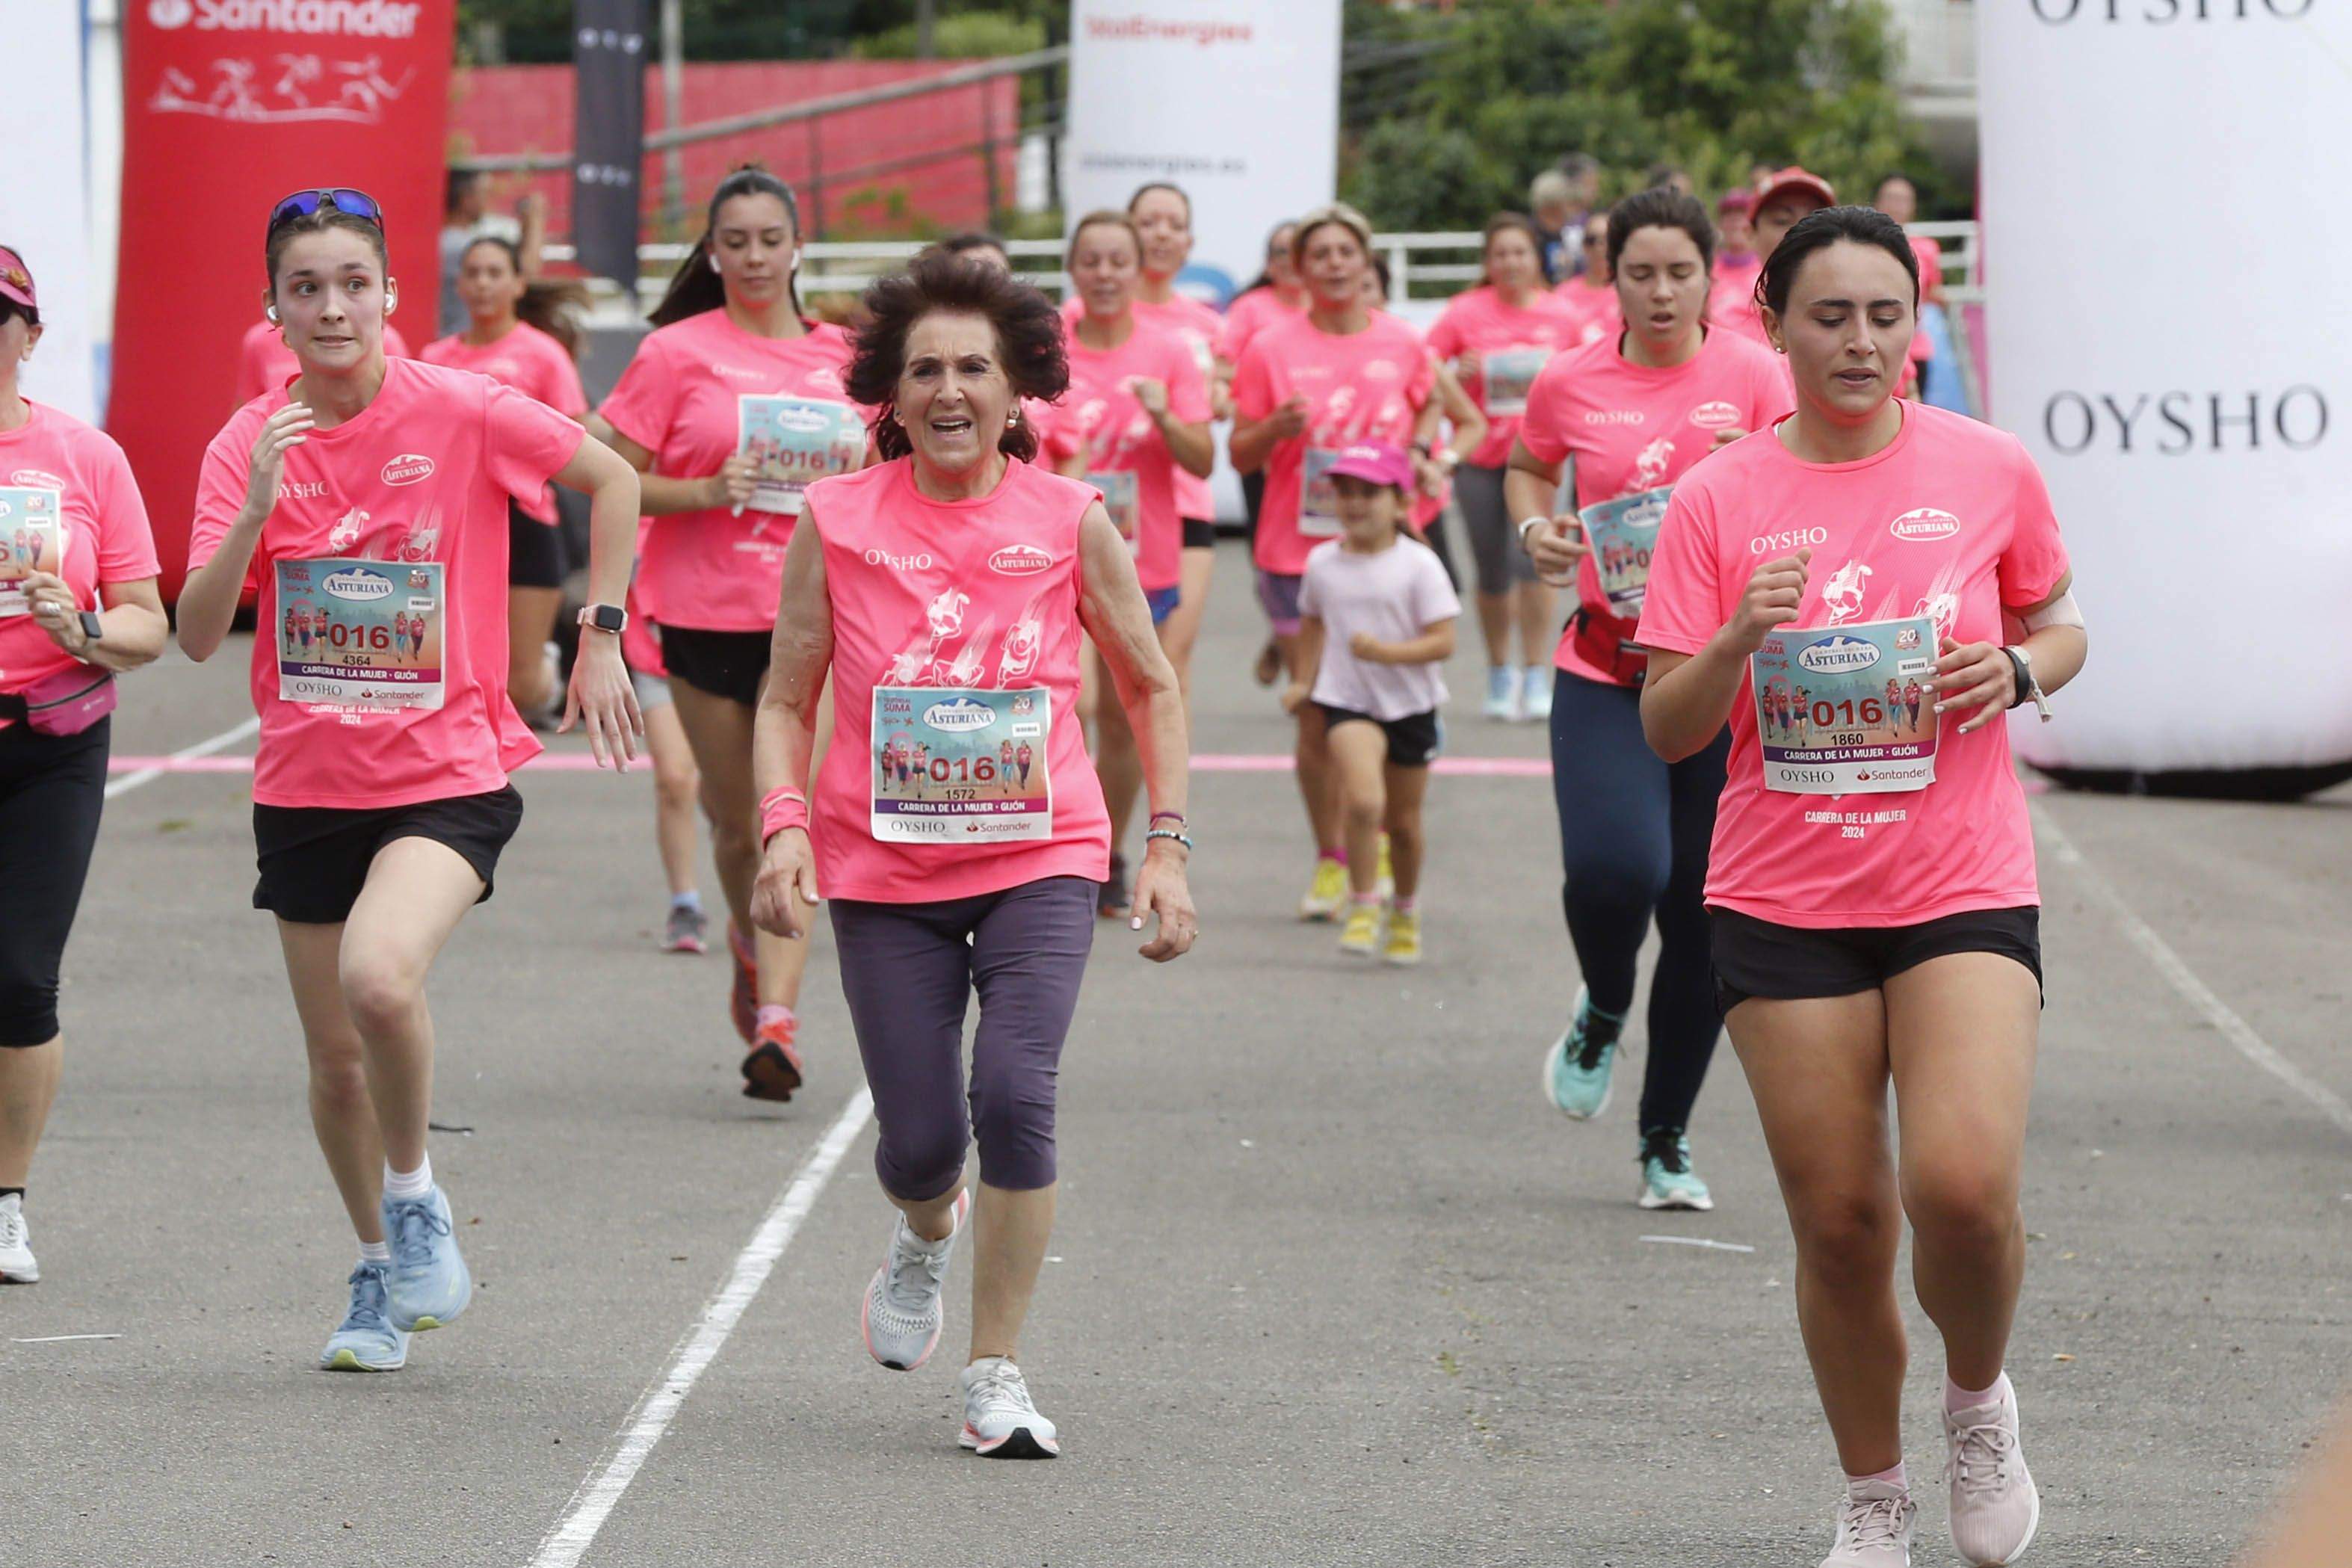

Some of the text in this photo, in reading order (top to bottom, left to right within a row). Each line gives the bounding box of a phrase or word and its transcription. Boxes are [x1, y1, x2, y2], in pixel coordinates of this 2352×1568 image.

[194, 0, 420, 38] Santander
[1585, 411, 1645, 425] OYSHO
[2044, 385, 2329, 456] OYSHO
[780, 450, 824, 469] 016
[385, 464, 430, 481] ASTURIANA
[1897, 522, 1955, 535] ASTURIANA
[1751, 527, 1827, 555] OYSHO
[865, 549, 933, 570] OYSHO
[995, 555, 1048, 569] ASTURIANA
[327, 580, 389, 594] ASTURIANA
[330, 623, 389, 649] 016
[1898, 631, 1916, 643] 20
[342, 655, 371, 665] 4364
[1804, 652, 1875, 667] ASTURIANA
[302, 665, 334, 676] CARRERA
[336, 668, 345, 677] DE
[348, 669, 357, 677] LA
[359, 669, 386, 679] MUJER
[296, 682, 342, 697] OYSHO
[374, 690, 424, 700] Santander
[883, 703, 911, 712] SUMA
[1014, 699, 1031, 709] 20
[927, 712, 992, 723] ASTURIANA
[1812, 698, 1883, 726] 016
[340, 714, 361, 725] 2024
[1831, 733, 1864, 746] 1860
[1784, 745, 1918, 760] CARRERA DE LA MUJER GIJÓN
[930, 756, 996, 783] 016
[1781, 769, 1834, 783] OYSHO
[1871, 768, 1927, 780] Santander
[945, 788, 975, 800] 1572
[898, 802, 935, 812] CARRERA
[938, 802, 949, 812] DE
[951, 802, 962, 812] LA
[964, 801, 993, 812] MUJER
[1805, 810, 1906, 824] CARRERA DE LA MUJER
[891, 821, 945, 833] OYSHO
[980, 823, 1031, 833] Santander
[1842, 826, 1864, 838] 2024
